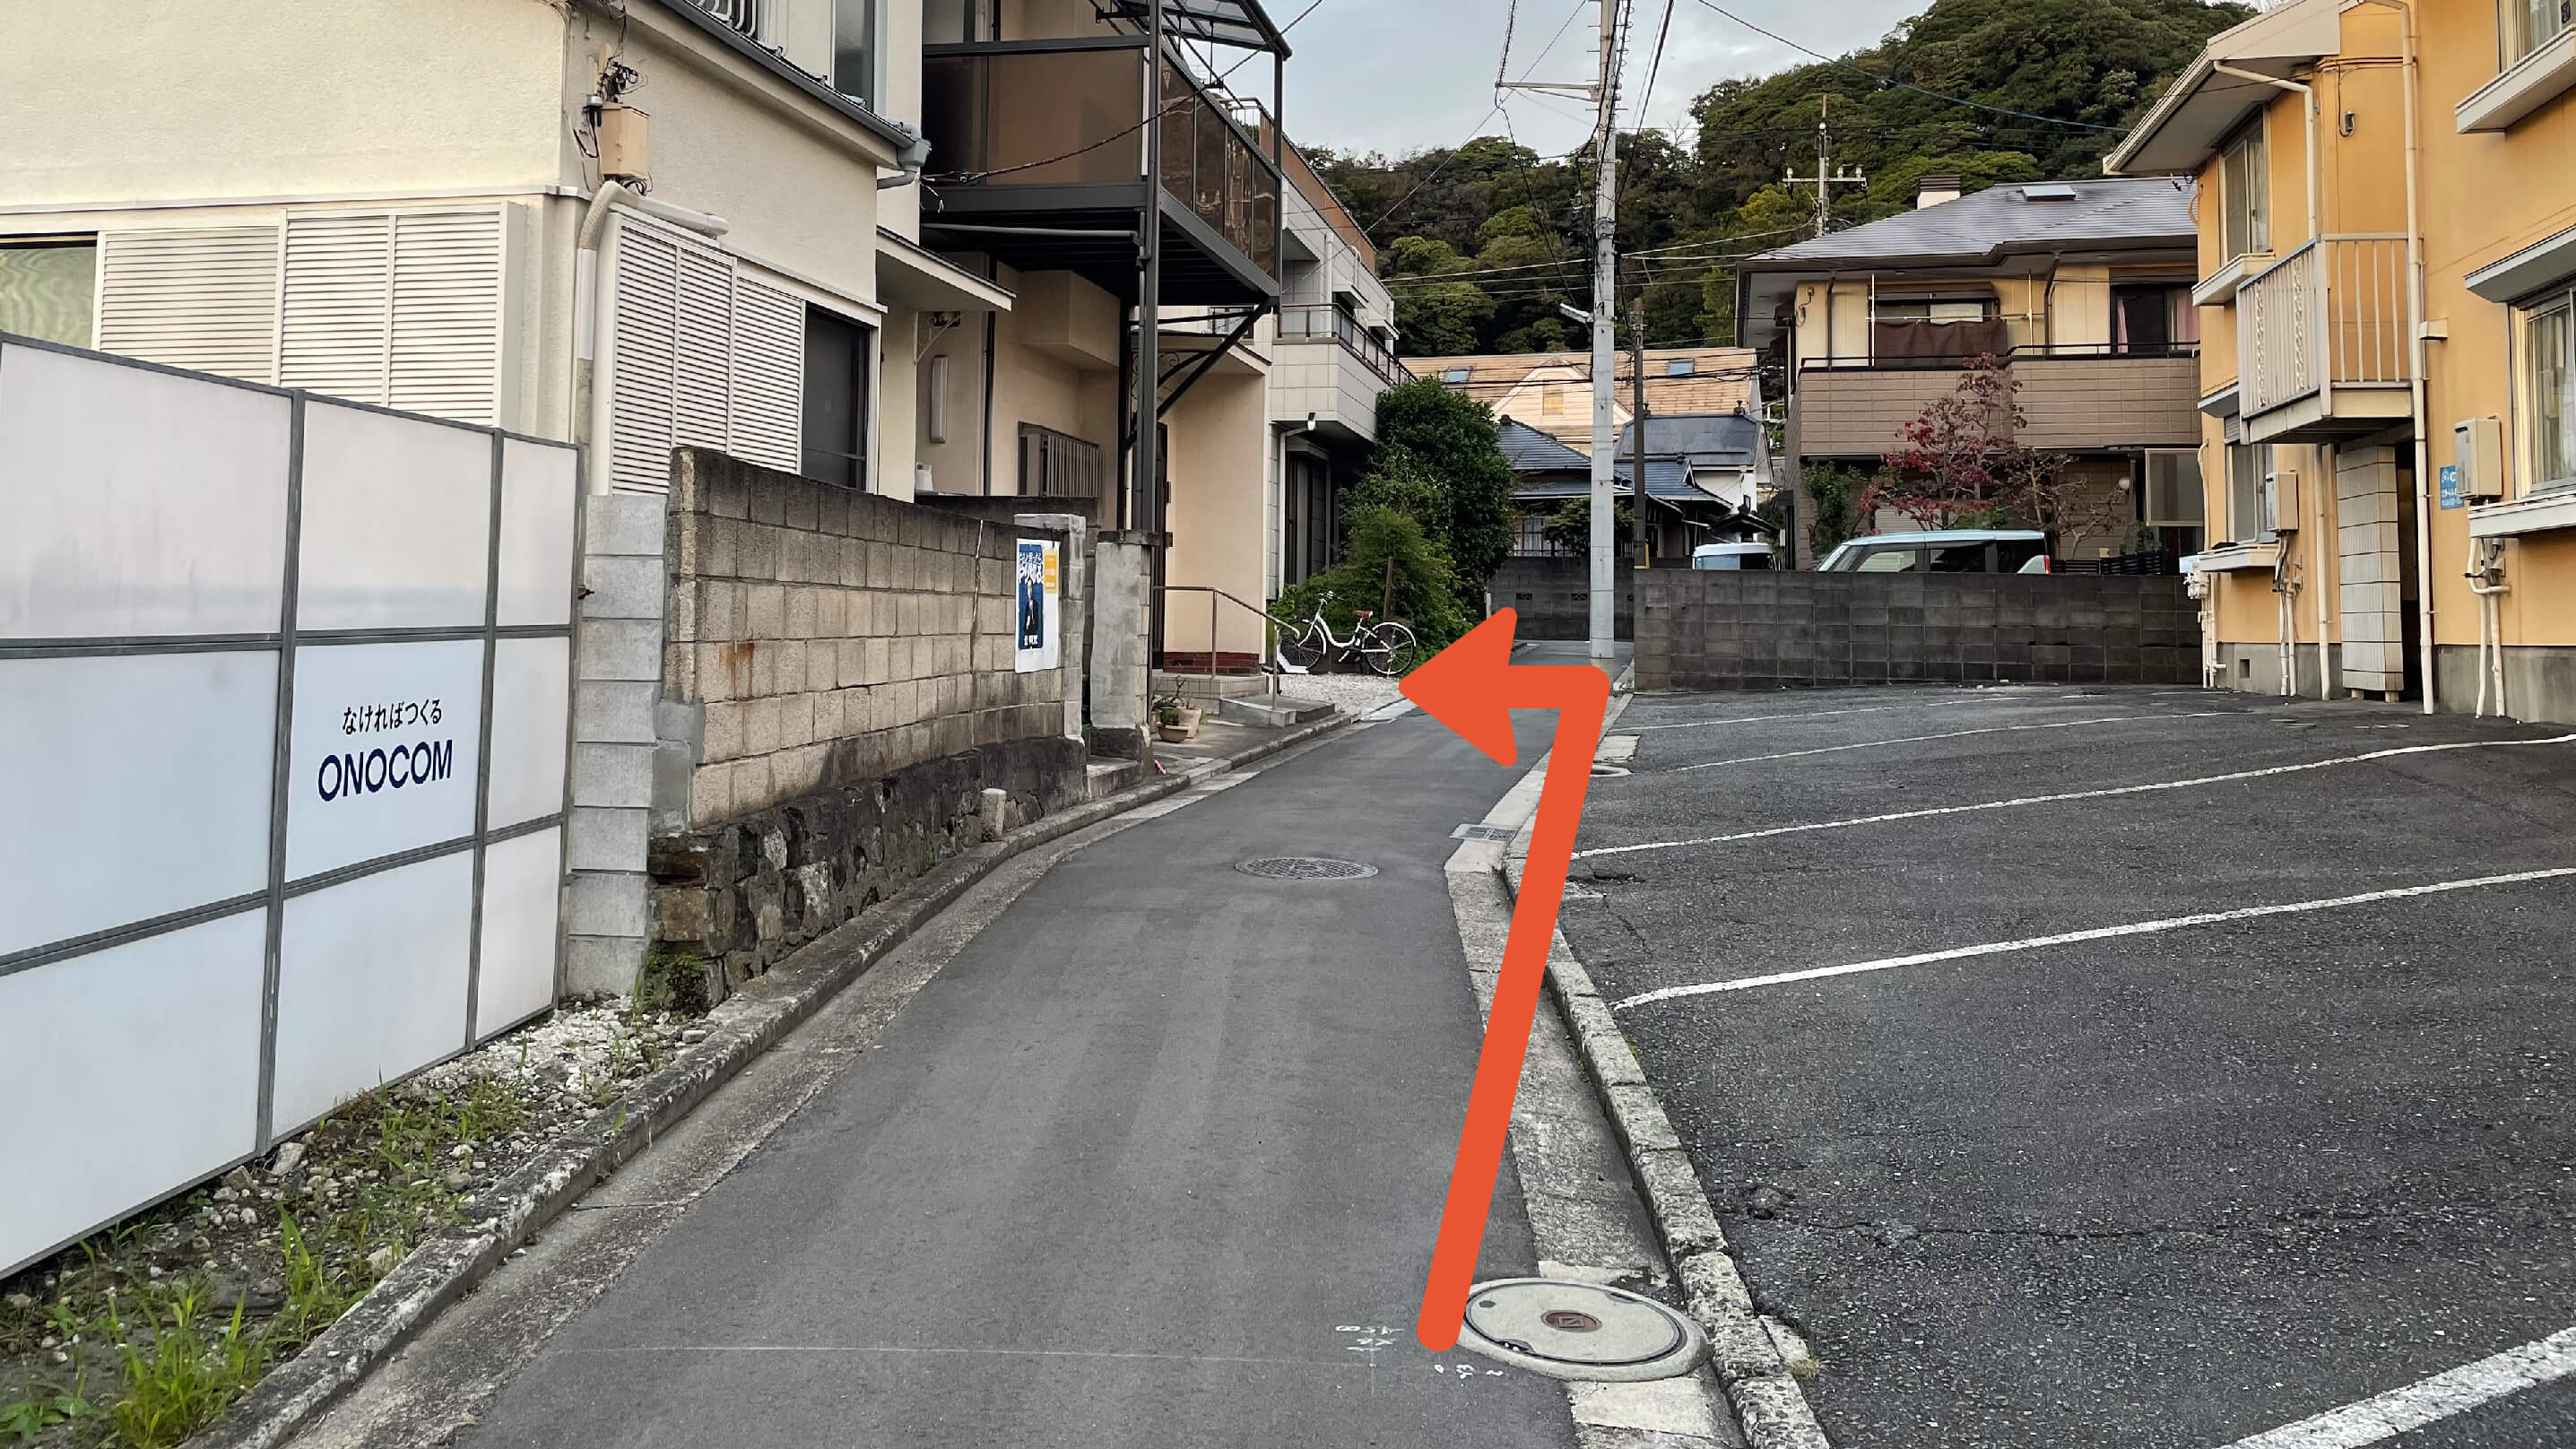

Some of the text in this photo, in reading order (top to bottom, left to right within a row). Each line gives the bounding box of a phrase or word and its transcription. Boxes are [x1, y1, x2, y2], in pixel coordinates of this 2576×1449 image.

[342, 698, 442, 735] なければつくる
[317, 739, 453, 802] ONOCOM
